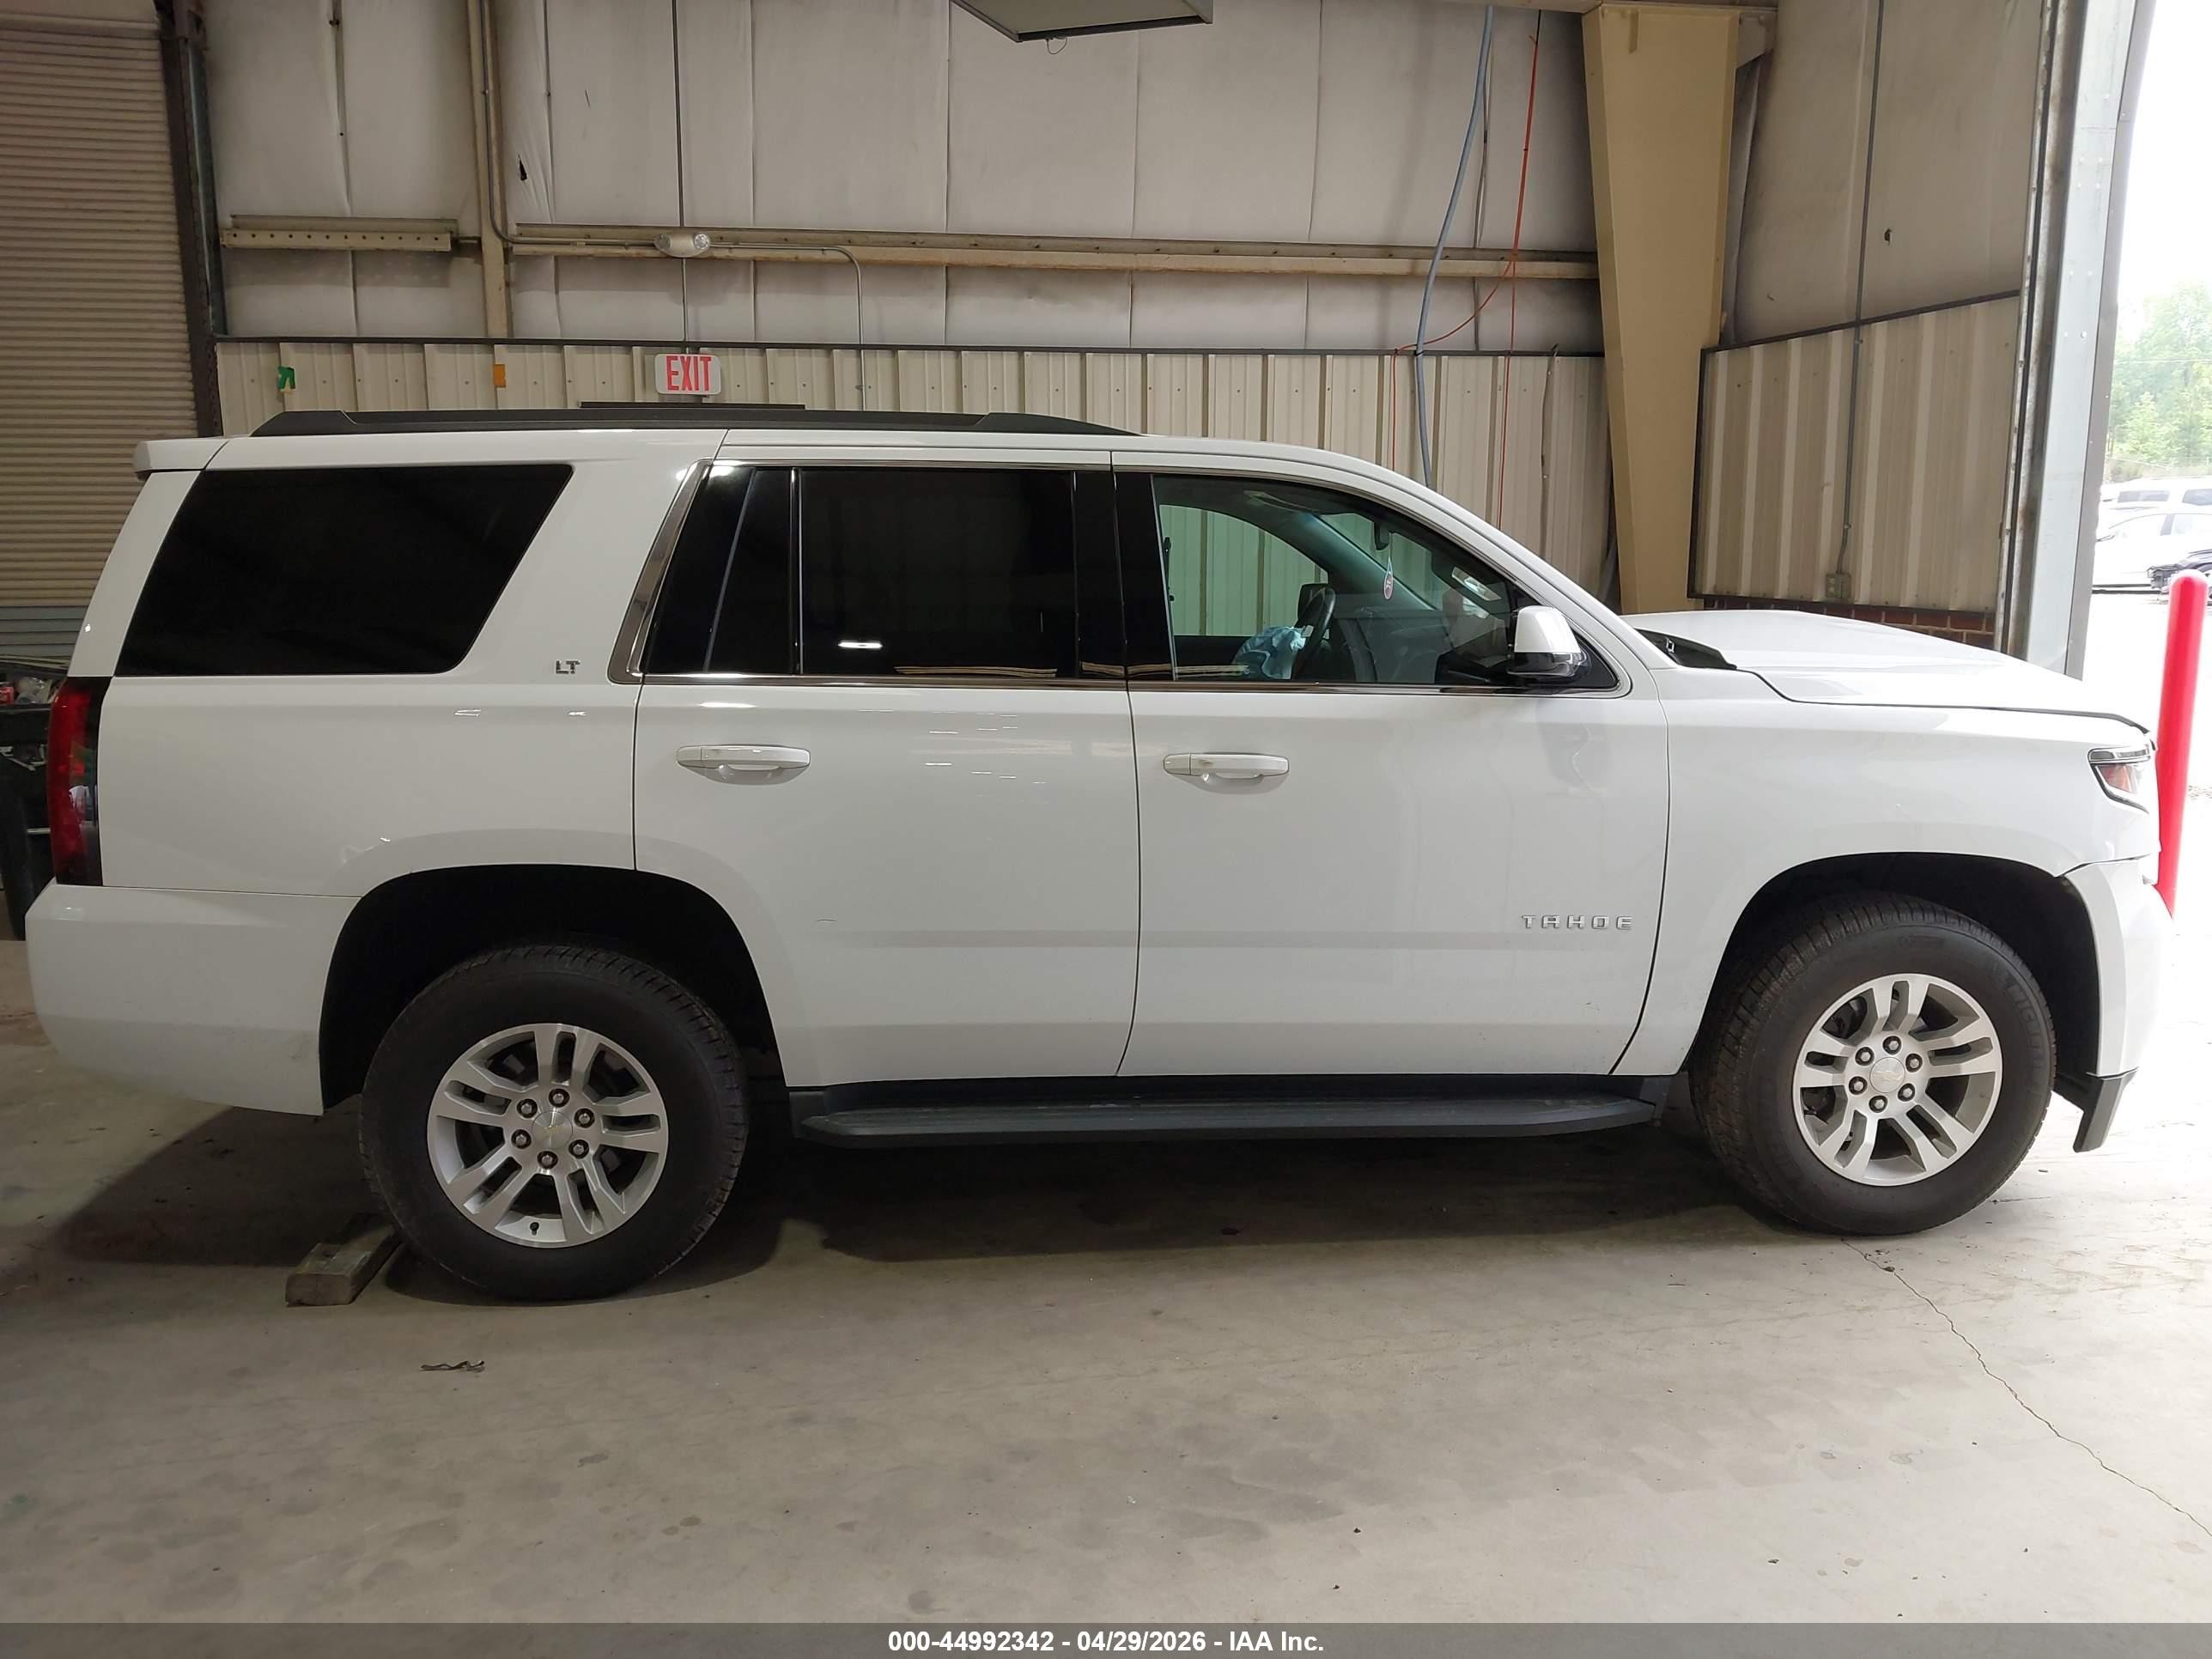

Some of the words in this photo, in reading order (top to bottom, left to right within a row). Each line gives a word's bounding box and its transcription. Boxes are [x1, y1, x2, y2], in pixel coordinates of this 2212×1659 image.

[665, 356, 712, 392] EXIT
[556, 659, 580, 673] LT
[1521, 915, 1634, 930] TAHOE
